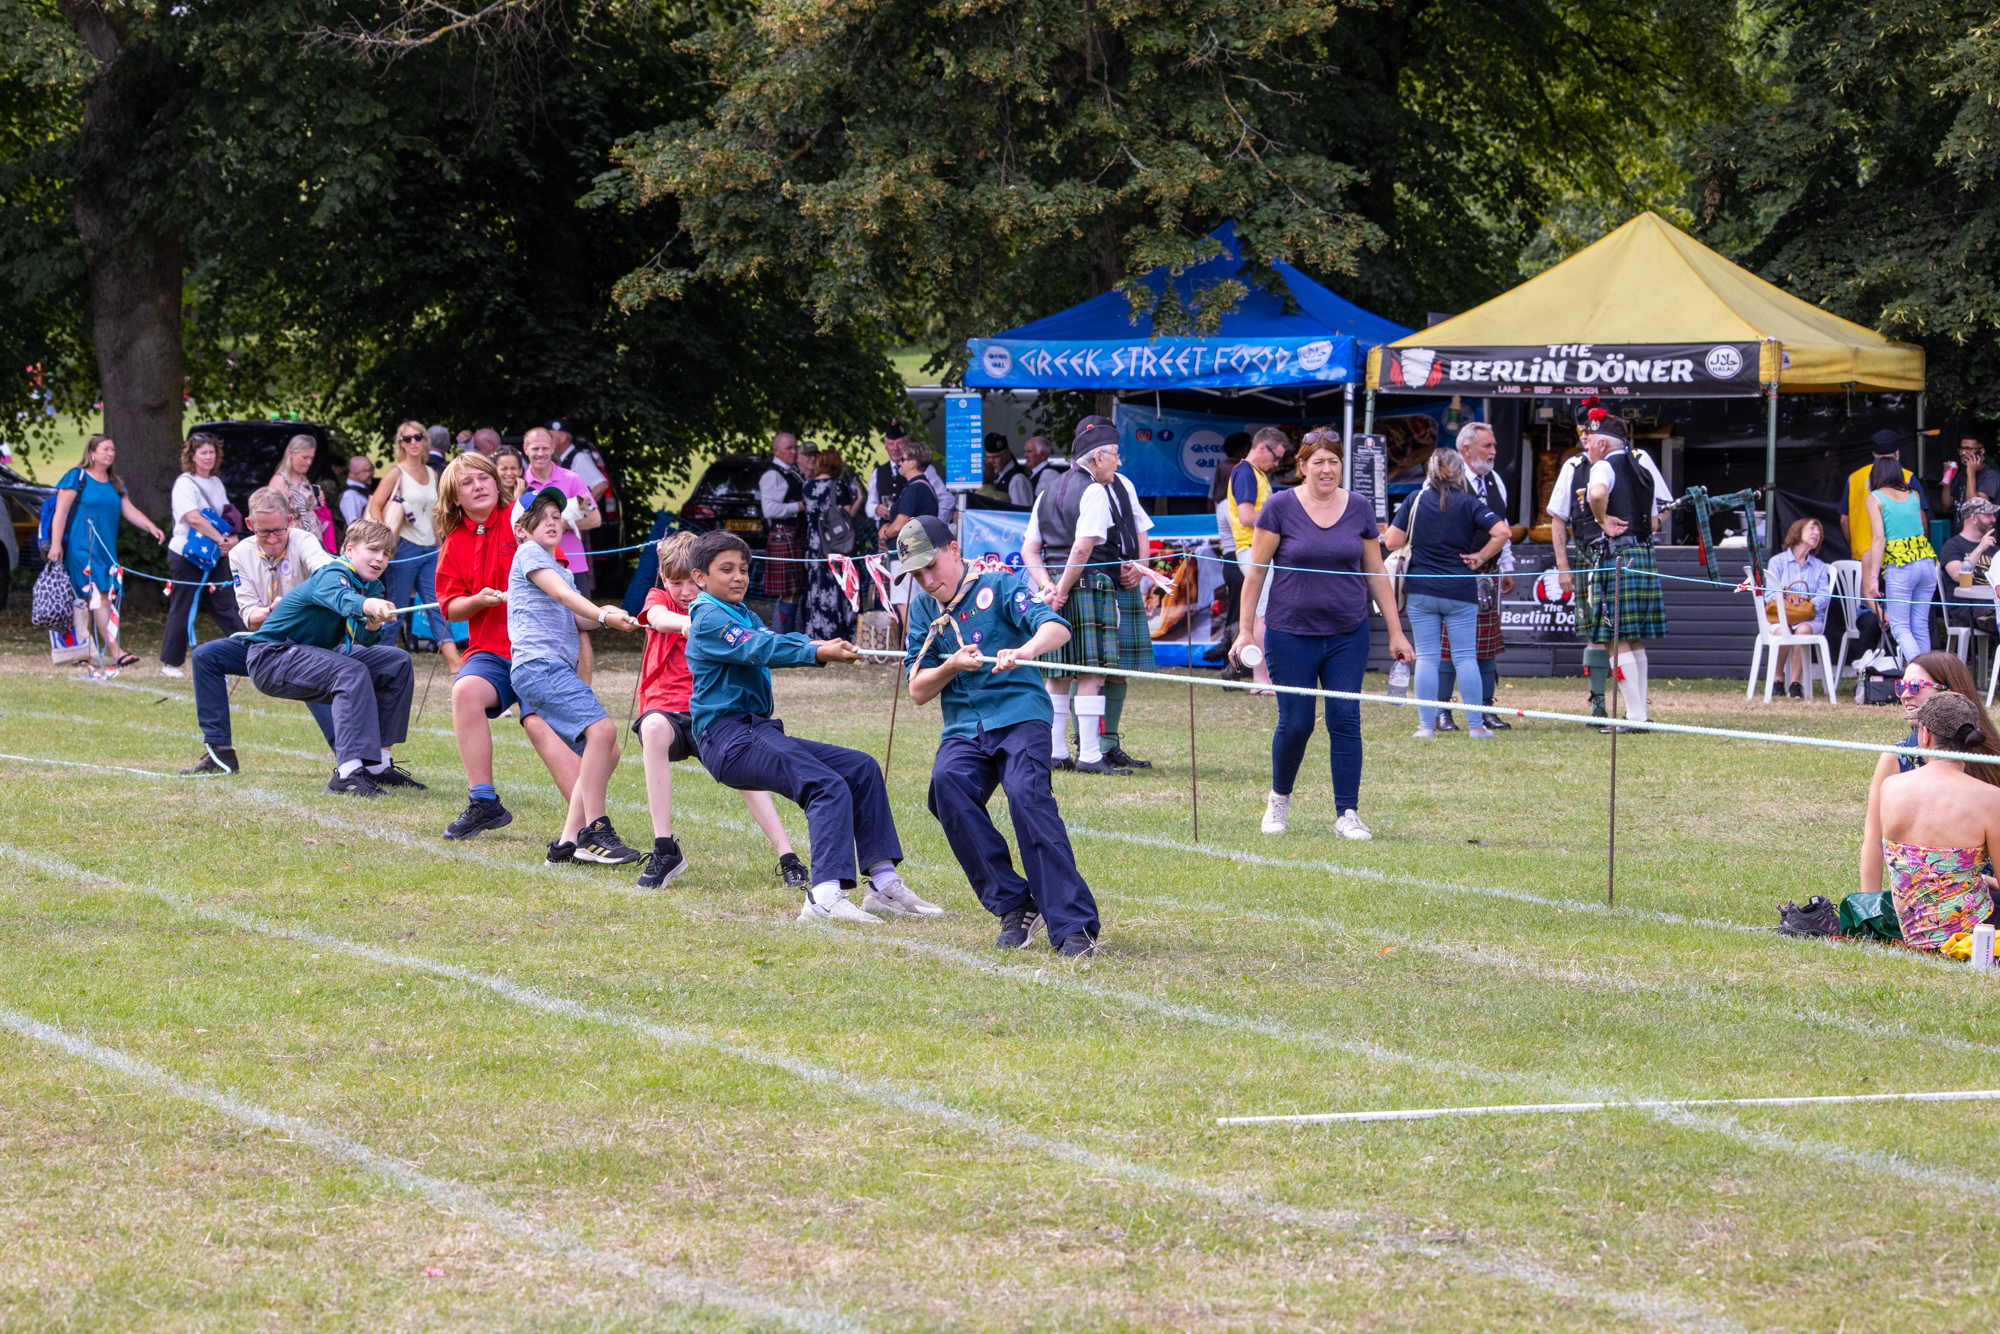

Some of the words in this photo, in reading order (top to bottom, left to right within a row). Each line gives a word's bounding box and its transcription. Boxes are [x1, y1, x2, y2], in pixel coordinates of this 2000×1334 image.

[1547, 344, 1593, 358] THE
[1018, 348, 1102, 376] GREEK
[1111, 346, 1207, 376] STREET
[1213, 347, 1292, 374] FOOD
[1710, 353, 1738, 366] حلال
[1577, 353, 1694, 383] DÖNER
[1498, 385, 1521, 394] LAMB
[1534, 386, 1553, 394] BEEF
[1564, 386, 1599, 395] CHICKEN
[1543, 603, 1564, 612] The
[1501, 610, 1552, 624] Berlin
